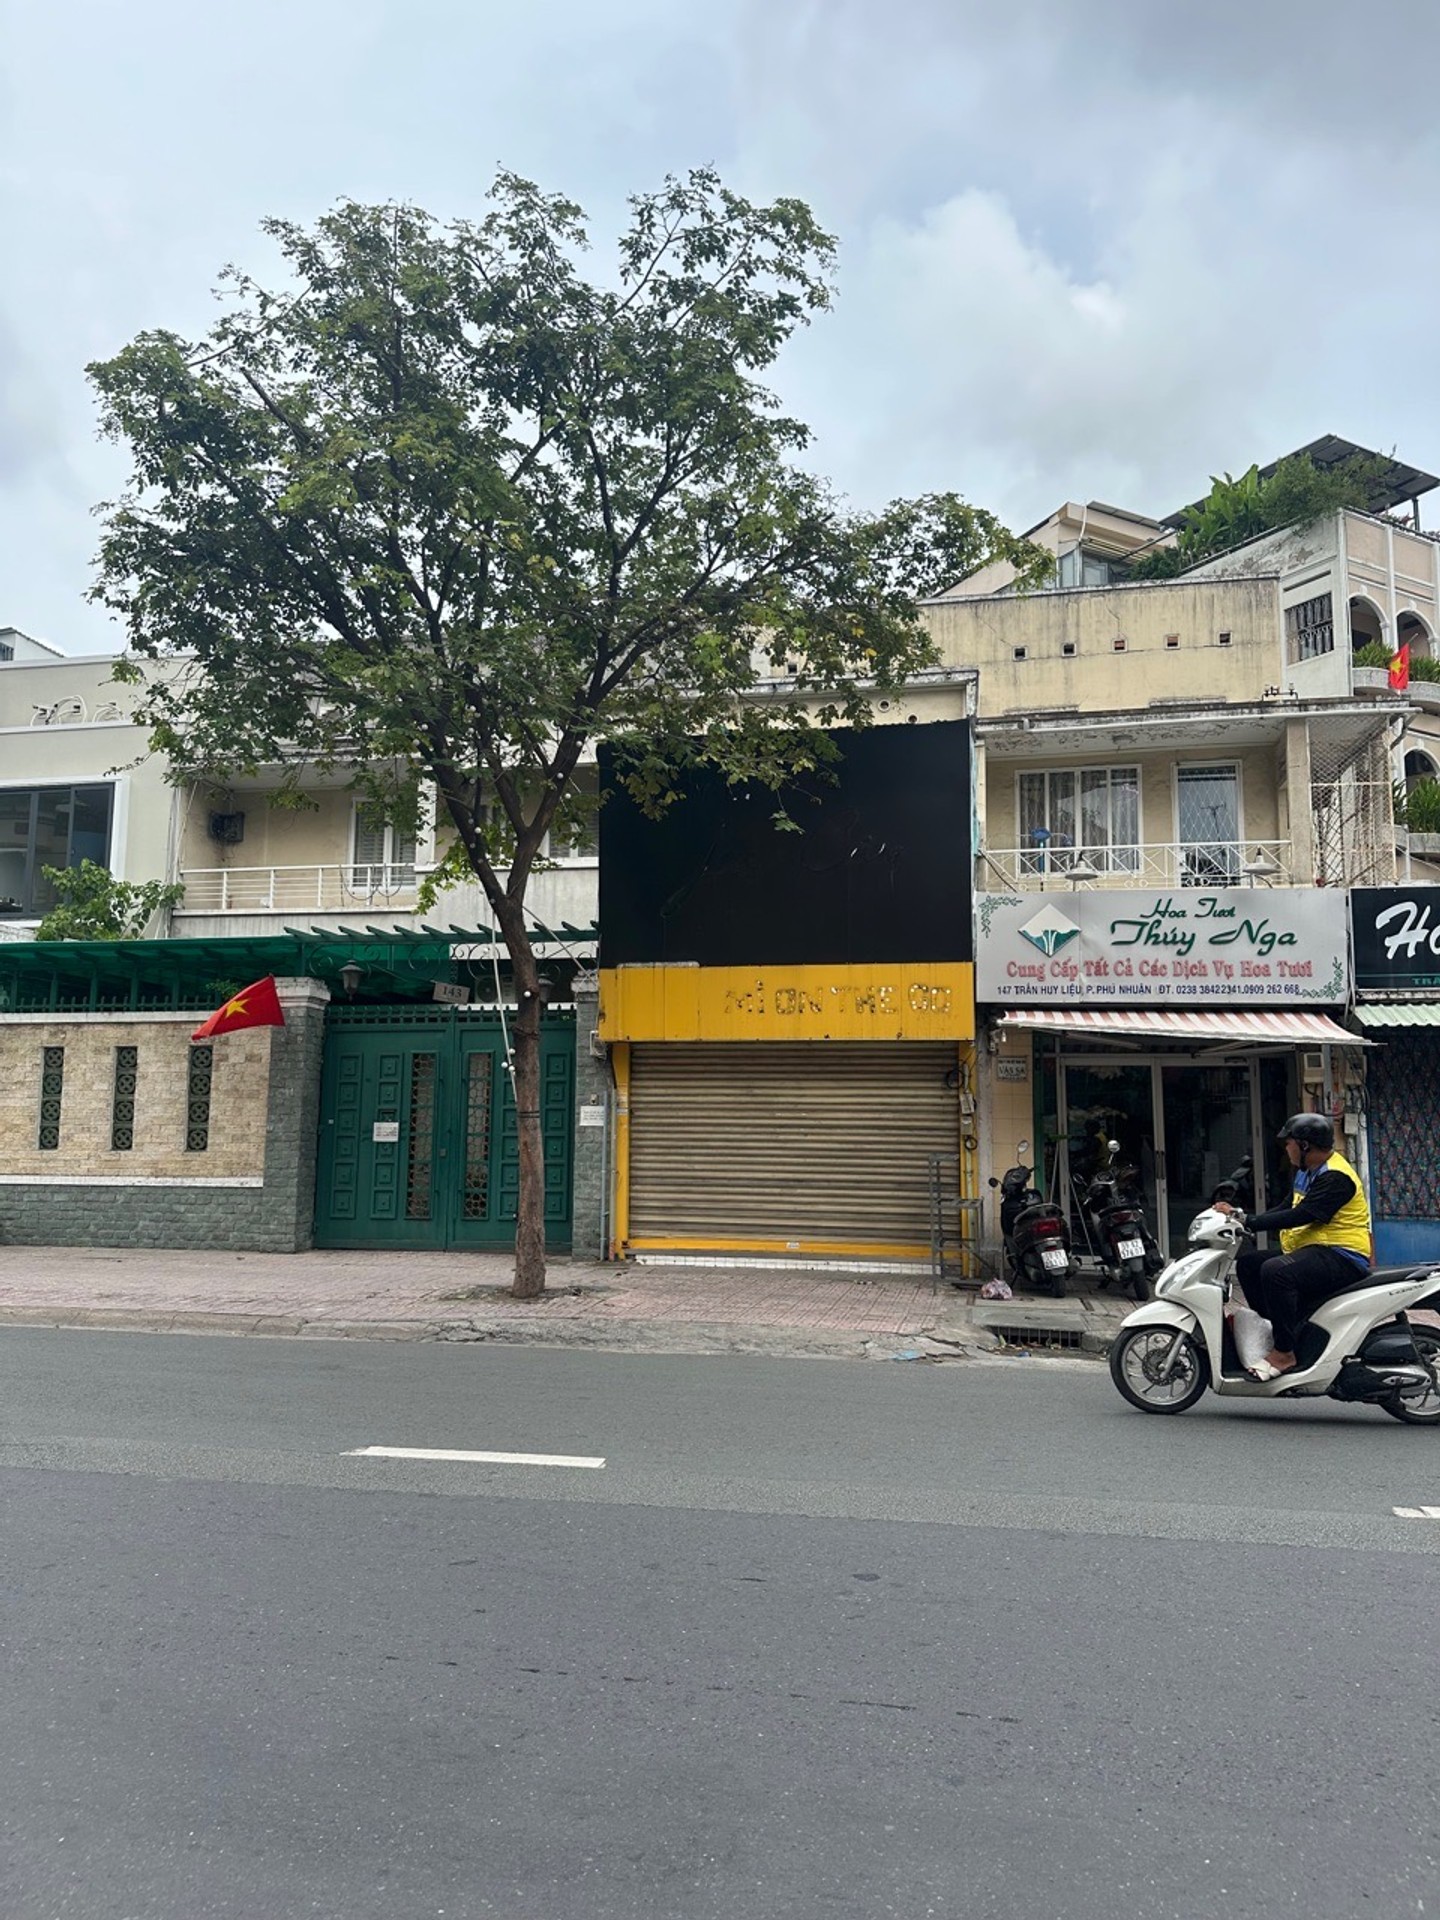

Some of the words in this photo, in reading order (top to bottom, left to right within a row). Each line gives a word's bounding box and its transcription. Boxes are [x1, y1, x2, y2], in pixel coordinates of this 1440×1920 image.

[1139, 898, 1188, 919] Hoa
[1194, 896, 1236, 919] Tươi
[1110, 918, 1196, 957] Thúy
[1208, 918, 1298, 957] Nga
[1006, 960, 1046, 982] Cung
[1050, 956, 1079, 982] Cấp
[1083, 955, 1109, 977] Tất
[1113, 957, 1134, 977] Cả
[1139, 957, 1168, 978] Các
[1172, 959, 1209, 980] Dịch
[1211, 959, 1234, 980] Vụ
[1239, 960, 1272, 978] Hoa
[1276, 959, 1313, 978] Tươi
[442, 985, 463, 999] 143
[997, 985, 1012, 995] 147
[1040, 985, 1059, 995] HUY
[1267, 984, 1282, 995] 262
